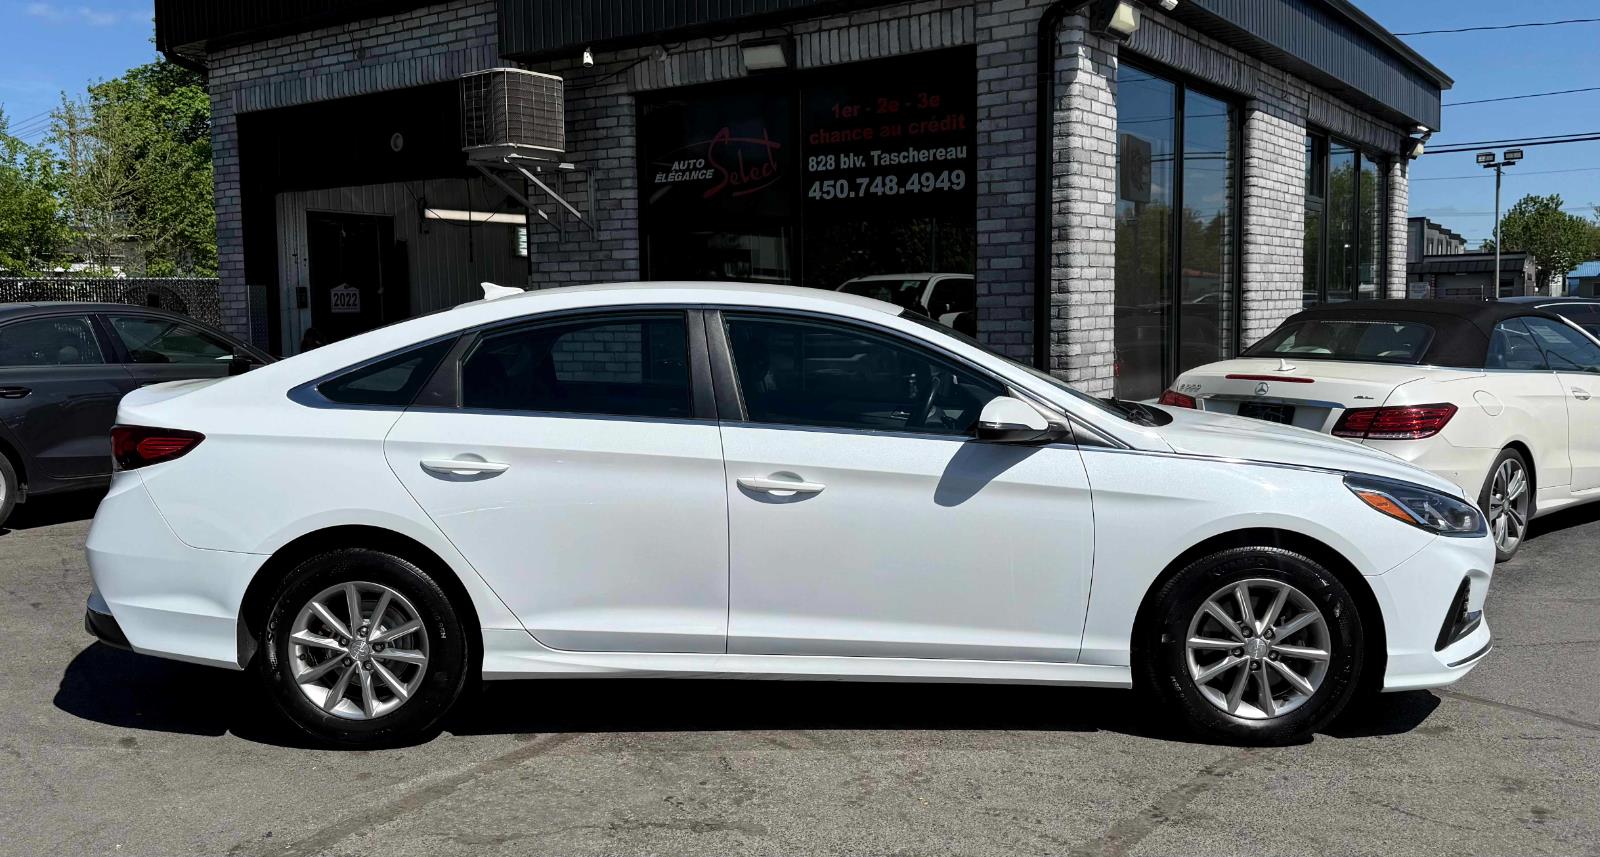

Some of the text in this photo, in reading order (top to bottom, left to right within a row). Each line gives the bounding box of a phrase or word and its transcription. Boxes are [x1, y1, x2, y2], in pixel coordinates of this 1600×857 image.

[832, 103, 861, 119] 1er
[877, 98, 899, 114] 2e
[917, 92, 941, 109] 3e
[808, 113, 967, 144] chance au crédit
[671, 159, 706, 171] AUTO
[703, 127, 783, 199] Select
[808, 145, 967, 172] 828 blv. Taschereau
[654, 168, 716, 183] ÉLÉGANCE
[808, 169, 967, 200] 450.748.4949
[333, 292, 358, 307] 2022
